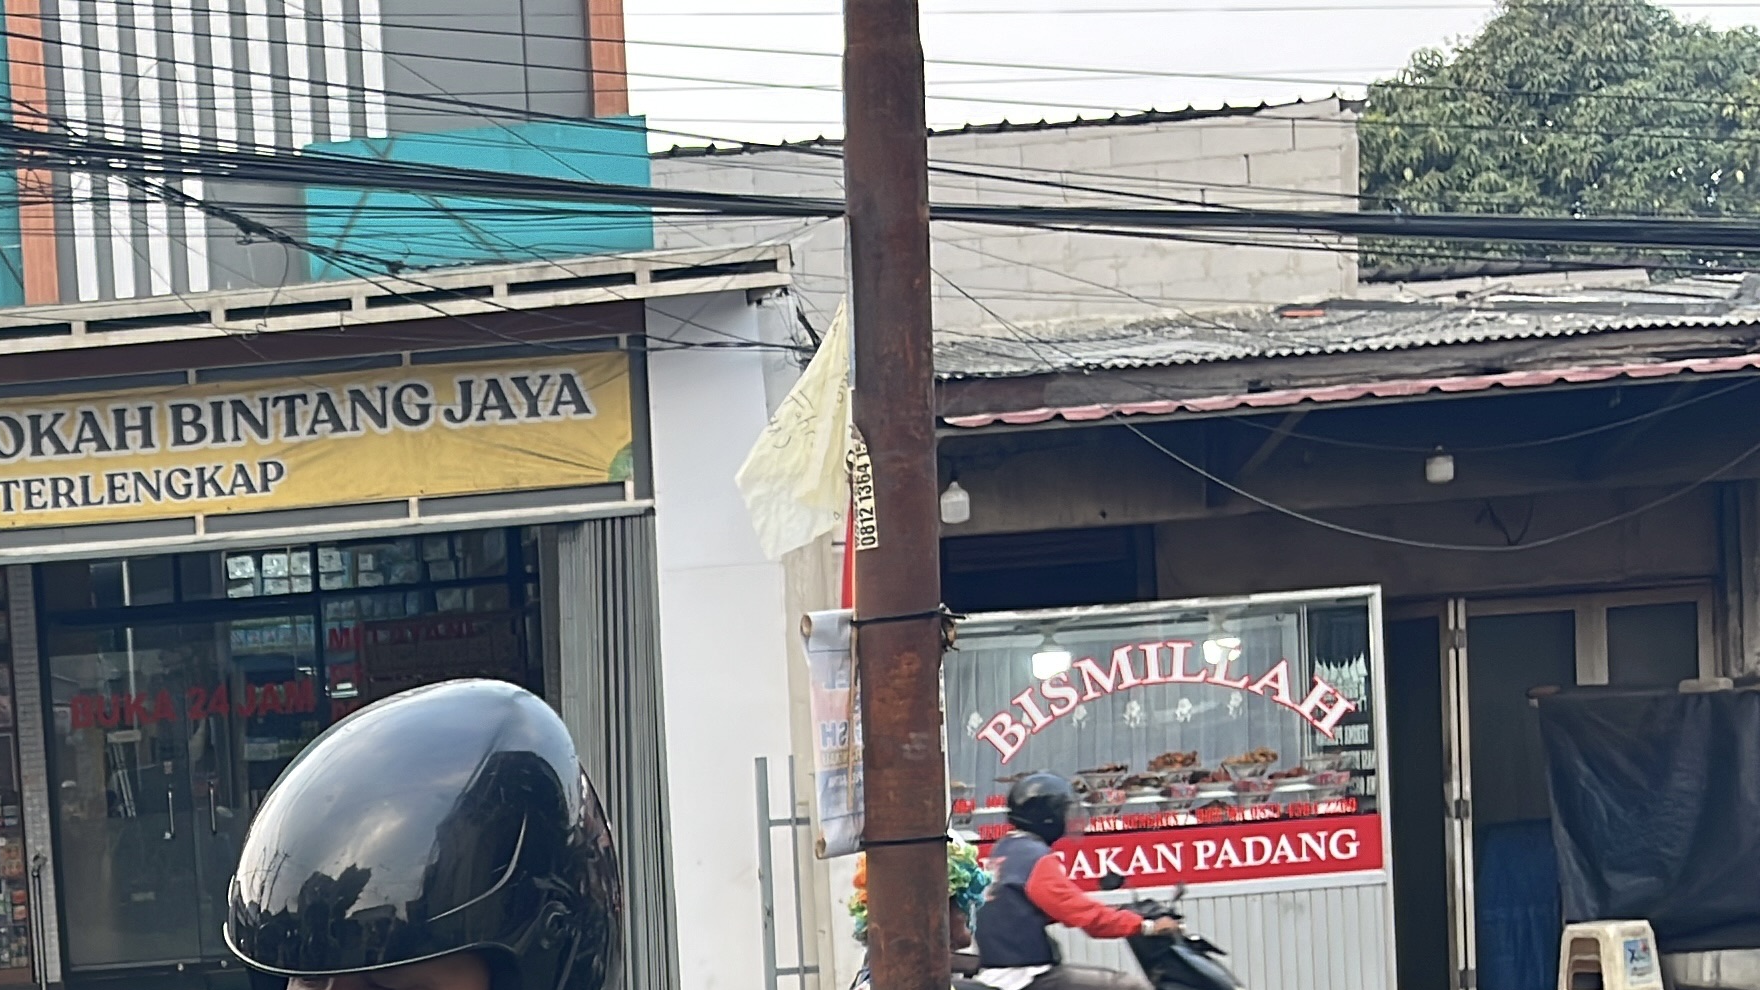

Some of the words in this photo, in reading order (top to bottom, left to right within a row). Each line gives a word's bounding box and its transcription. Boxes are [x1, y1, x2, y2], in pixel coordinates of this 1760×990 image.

[169, 382, 432, 447] BINTANG
[443, 373, 593, 424] JAYA
[856, 463, 873, 503] 1364
[859, 506, 877, 547] 0812
[71, 689, 177, 729] BUKA
[188, 685, 229, 720] 24
[239, 678, 317, 717] JAM
[978, 640, 1355, 764] BISMILLAH
[1193, 829, 1360, 871] PADANG
